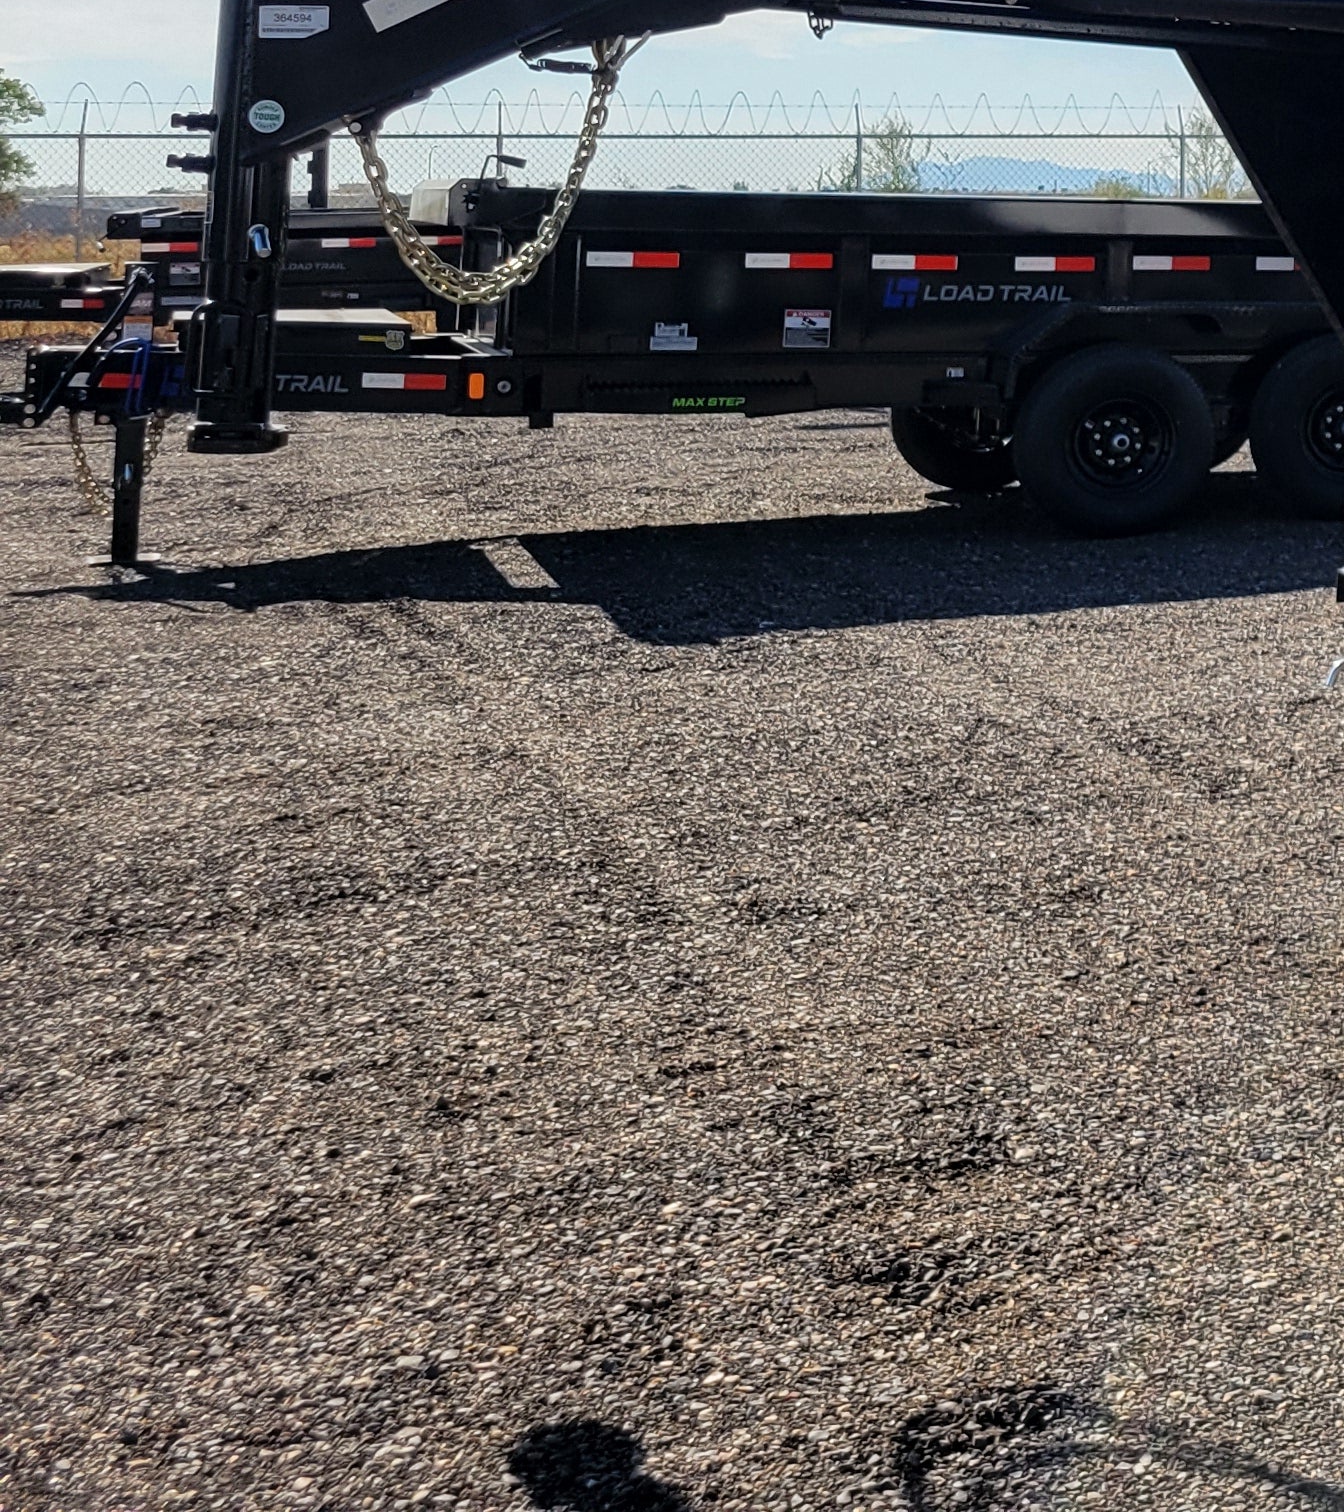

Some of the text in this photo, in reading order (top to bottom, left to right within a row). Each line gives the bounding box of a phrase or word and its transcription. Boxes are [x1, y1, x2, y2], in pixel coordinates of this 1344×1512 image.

[273, 12, 313, 23] 364594
[923, 284, 1072, 302] LOAD TRAIL
[3, 298, 44, 310] TRAIL
[275, 374, 349, 393] TRAIL
[672, 396, 746, 407] MAX STEP
